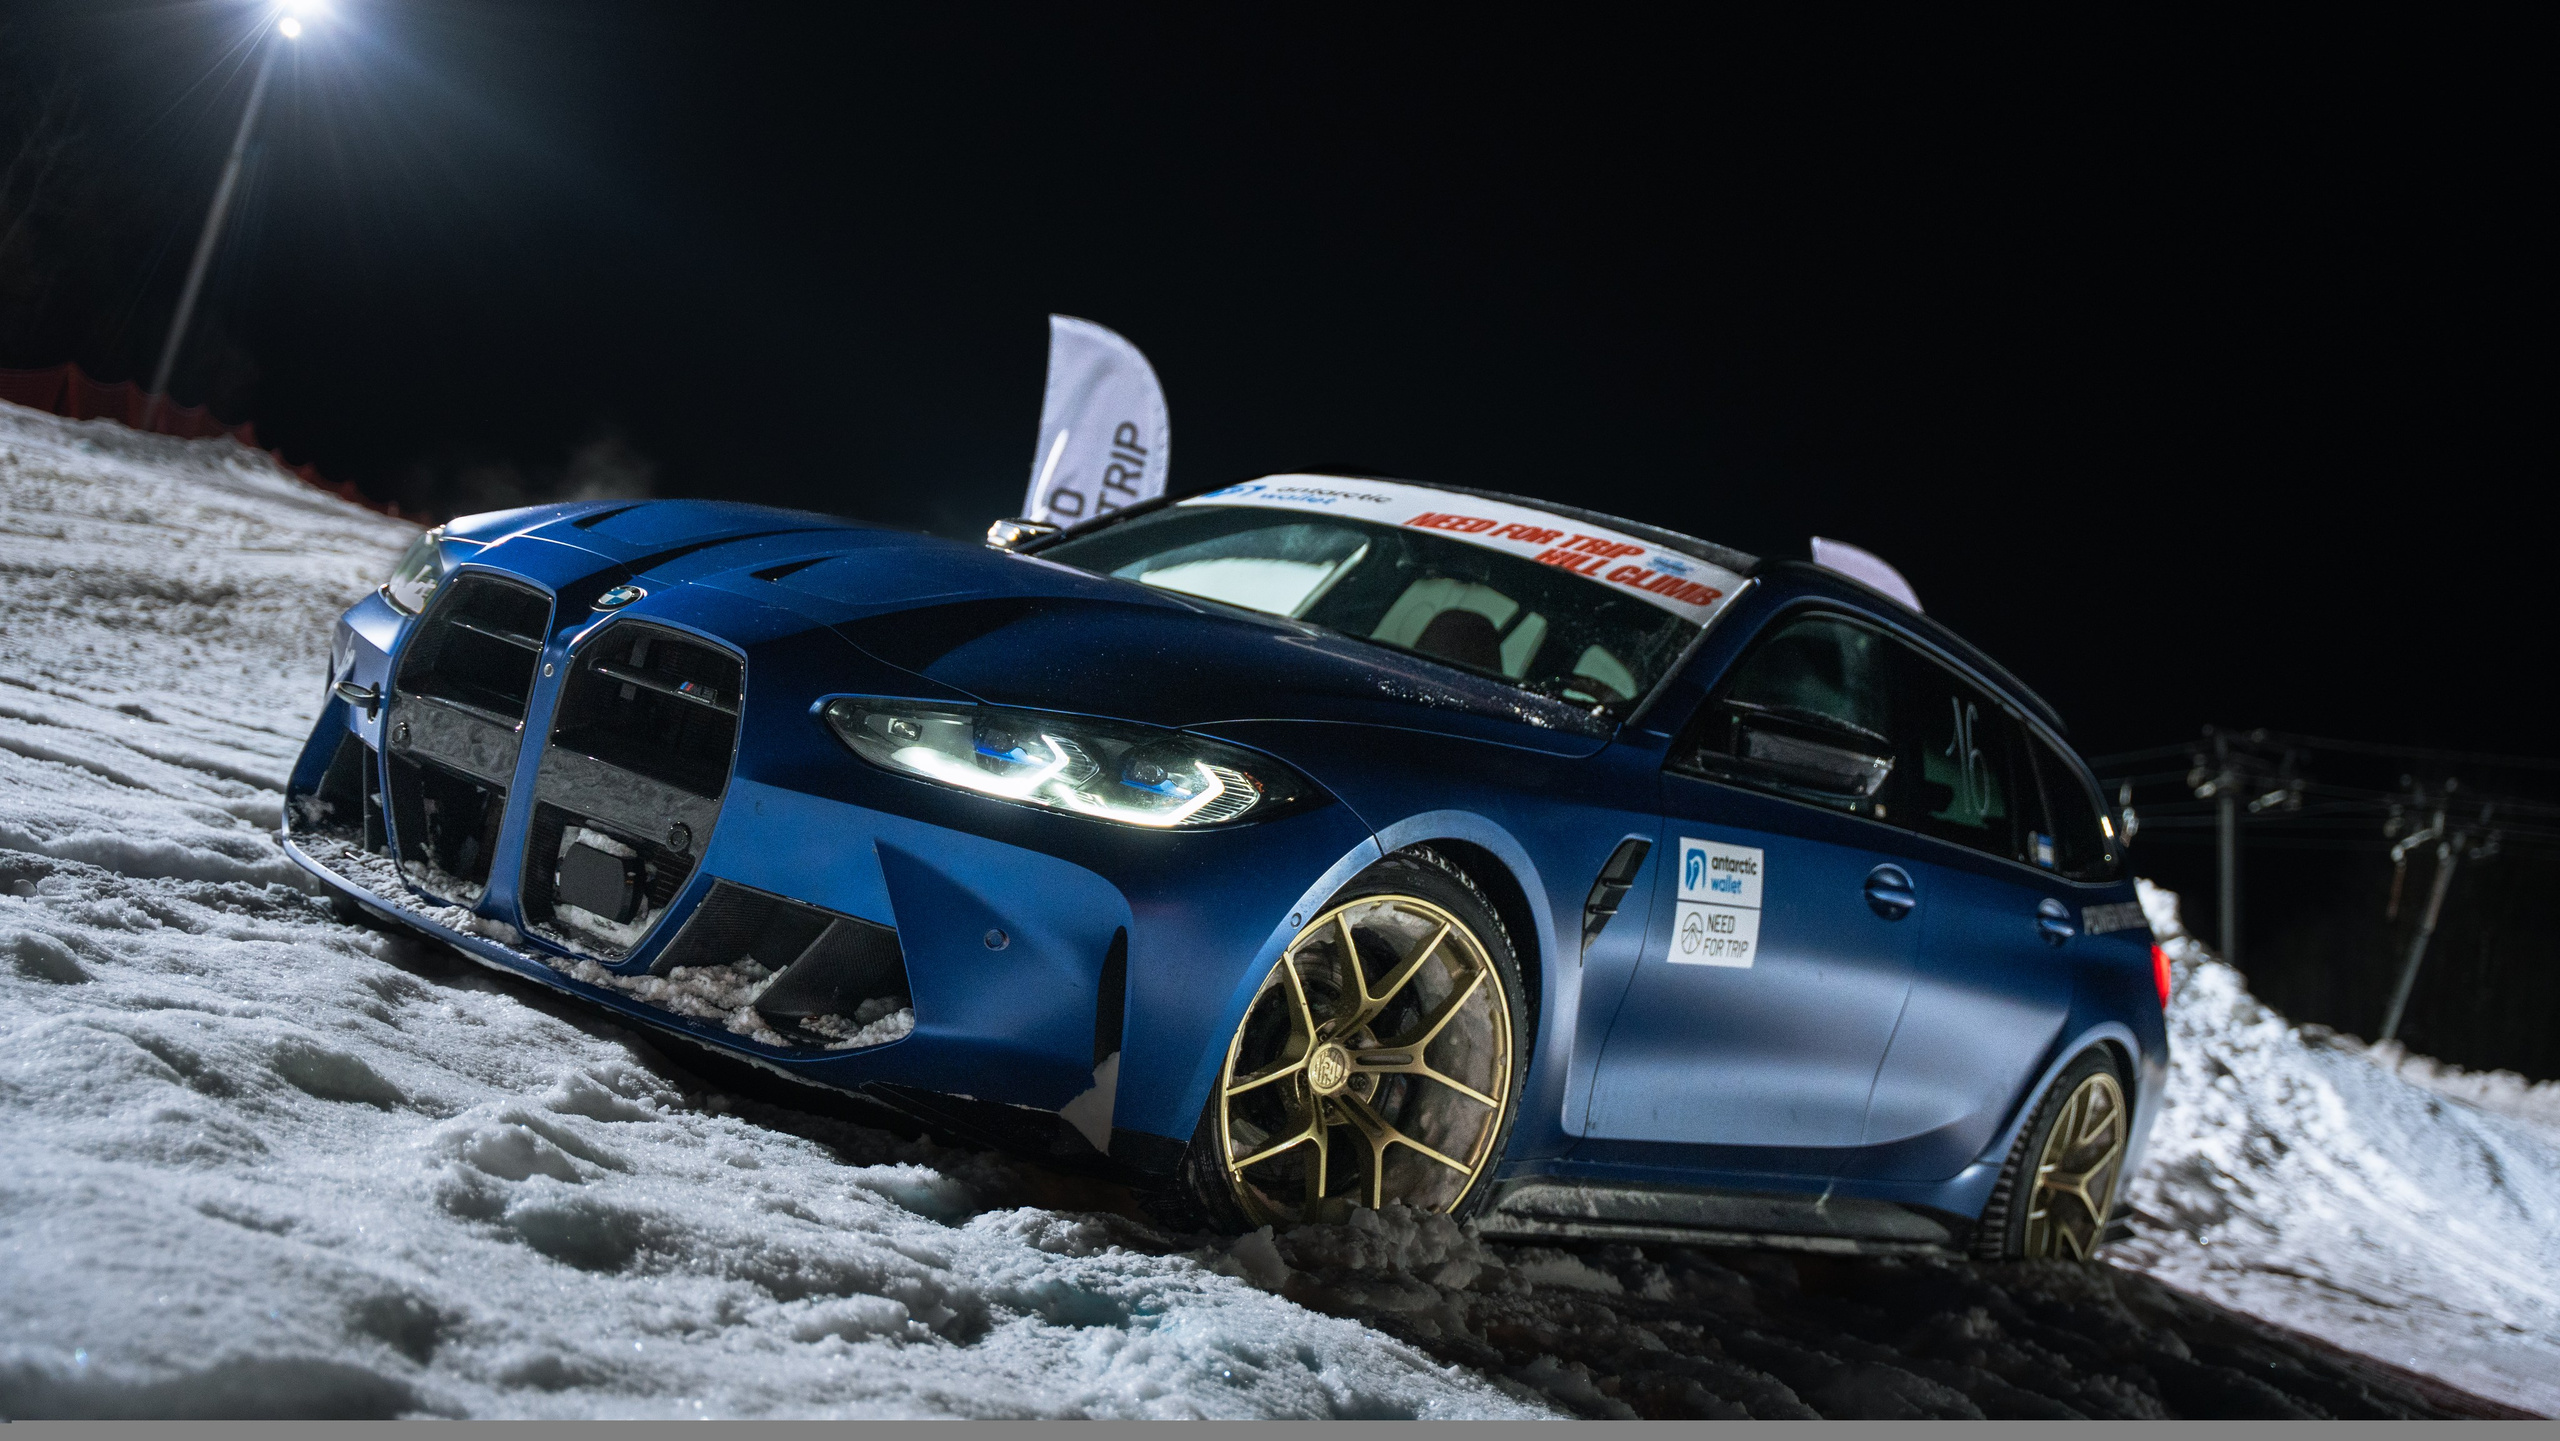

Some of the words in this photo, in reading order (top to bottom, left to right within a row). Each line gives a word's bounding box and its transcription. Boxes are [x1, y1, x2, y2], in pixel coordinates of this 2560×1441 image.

[1095, 421, 1148, 513] TRIP
[1276, 485, 1394, 504] antarctic
[1402, 512, 1498, 533] NEED
[1486, 523, 1563, 545] FOR
[1557, 534, 1646, 559] TRIP
[1534, 548, 1611, 577] HILL
[1605, 565, 1723, 607] CLIMB
[1711, 855, 1758, 876] antarctic
[1710, 875, 1743, 894] wallet
[1706, 914, 1736, 935] NEED
[1702, 938, 1724, 957] FOR
[1725, 940, 1749, 959] TRIP
